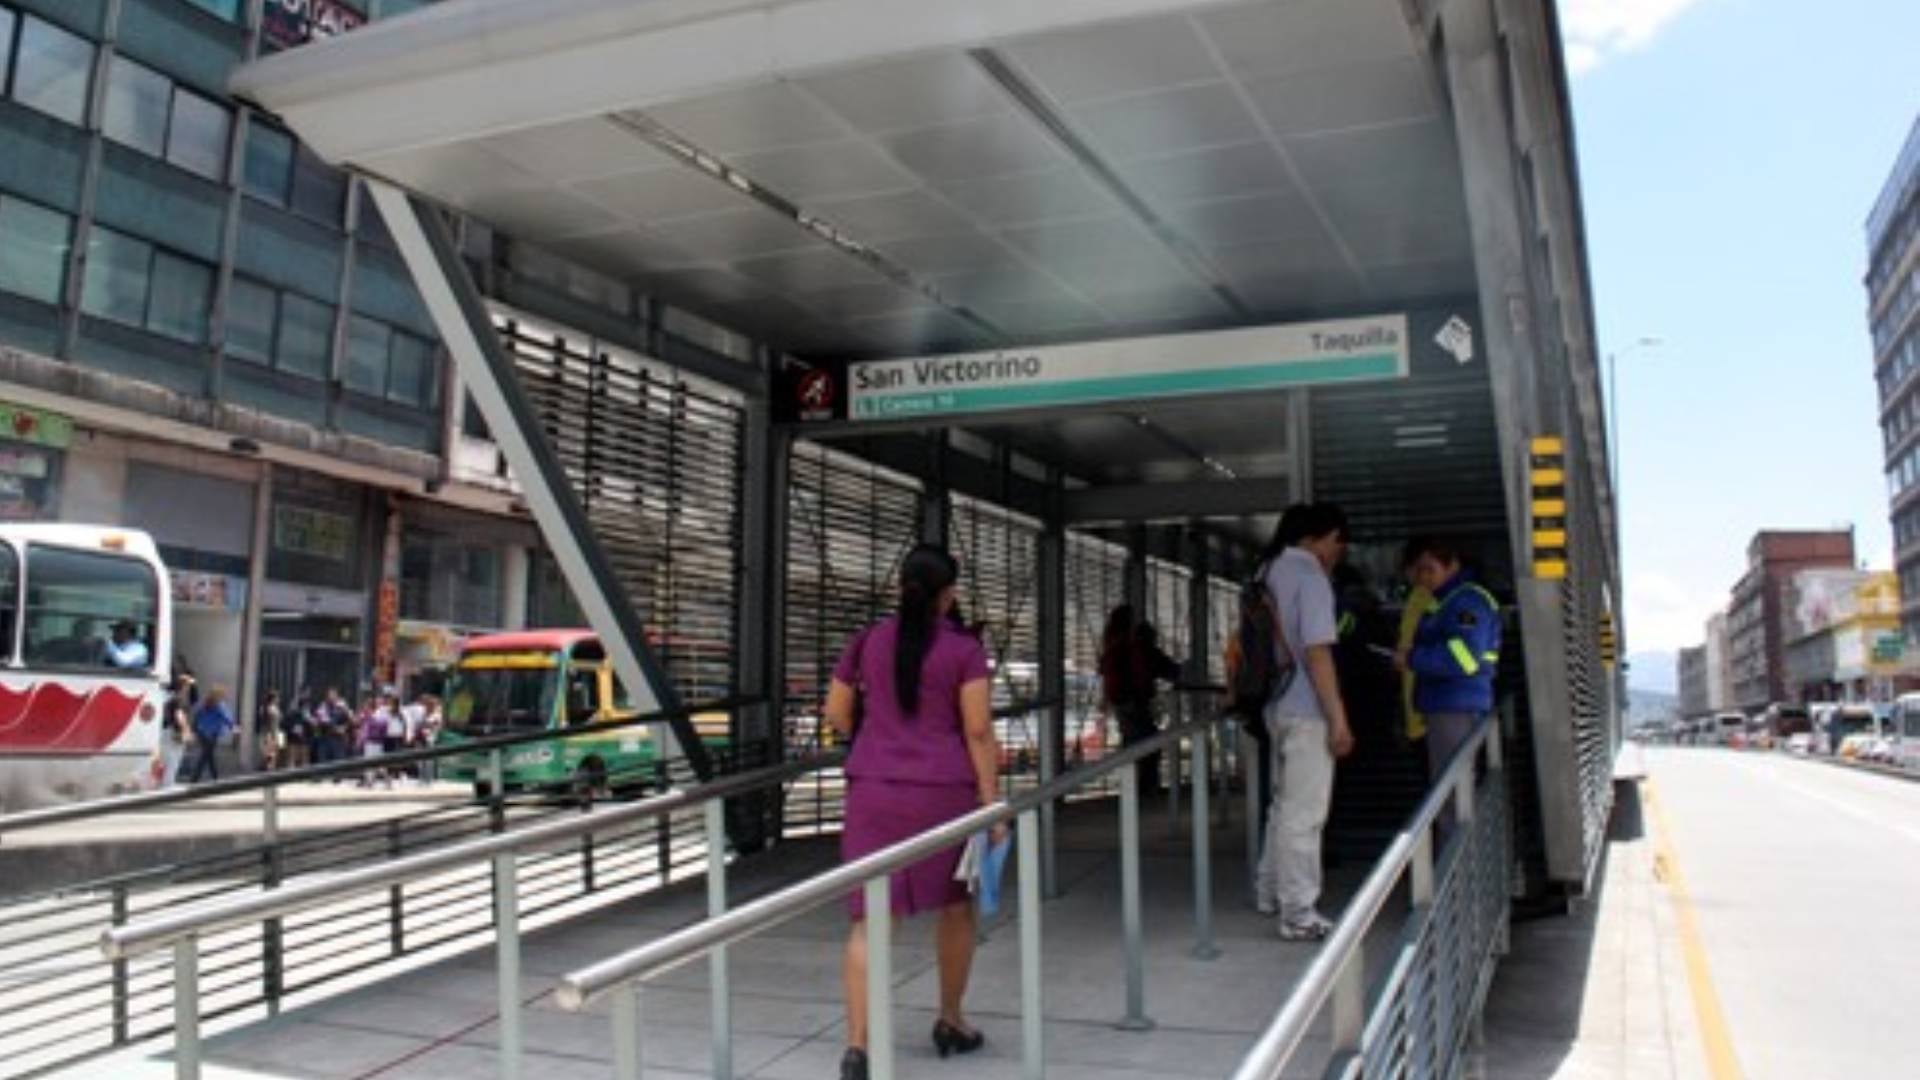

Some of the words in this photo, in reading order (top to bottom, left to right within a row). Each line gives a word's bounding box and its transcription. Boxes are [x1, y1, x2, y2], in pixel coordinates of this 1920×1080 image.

[1311, 326, 1399, 353] Taquilla
[855, 364, 904, 389] San
[914, 353, 1041, 385] Victorino
